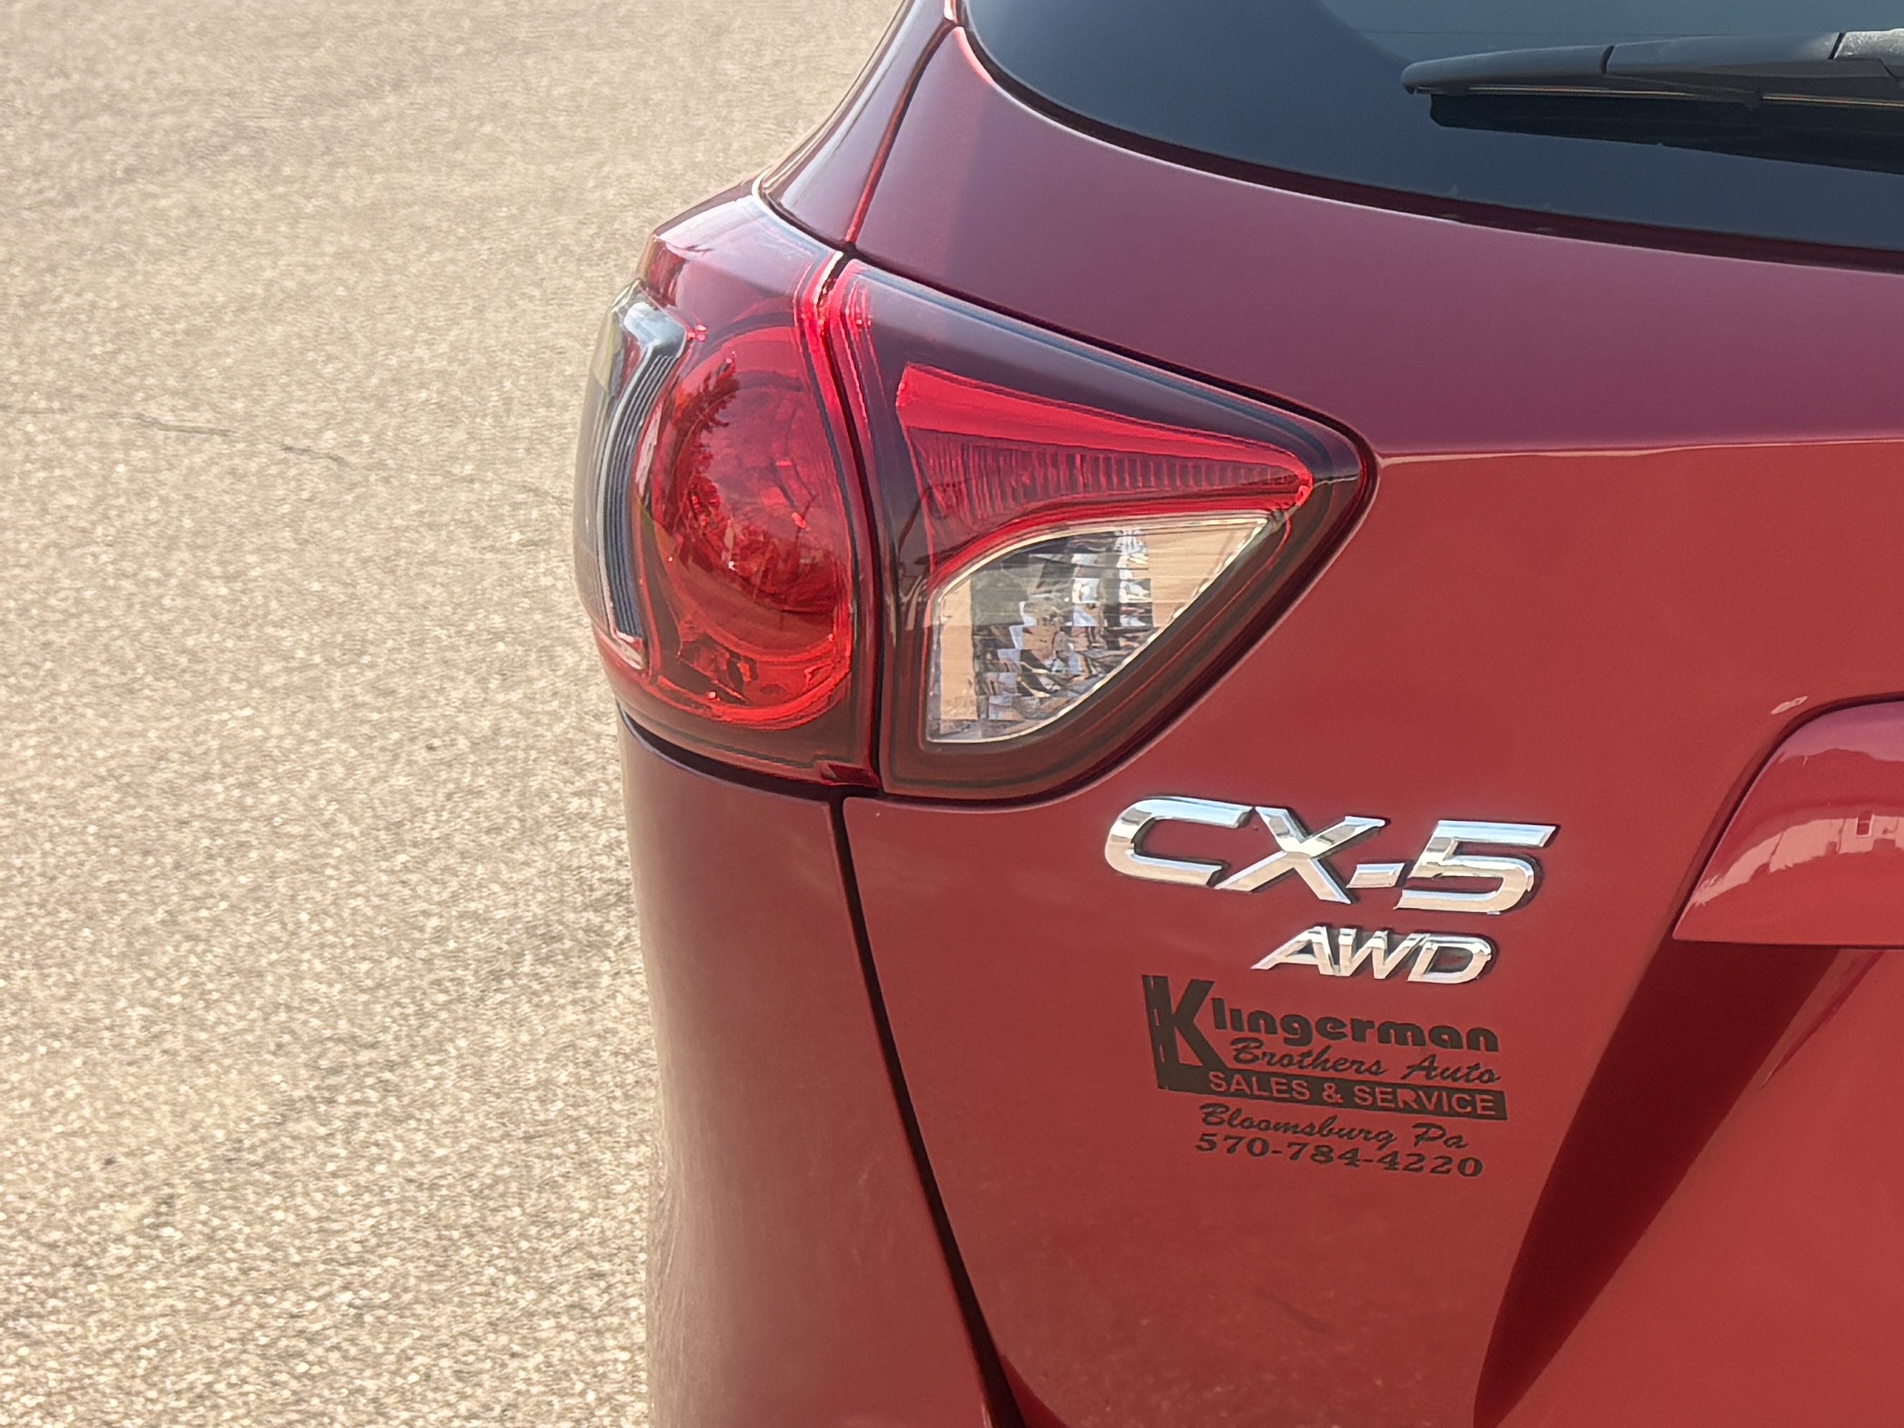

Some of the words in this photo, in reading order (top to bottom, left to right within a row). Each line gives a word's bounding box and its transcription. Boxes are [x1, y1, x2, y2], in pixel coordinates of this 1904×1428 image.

[1103, 795, 1561, 916] CX-5
[1250, 924, 1496, 985] AWD
[1141, 974, 1500, 1070] Klingerman
[1230, 1037, 1388, 1081] Brothers
[1401, 1053, 1501, 1086] Auto
[1208, 1071, 1312, 1102] SALES
[1321, 1082, 1345, 1106] &
[1353, 1084, 1500, 1116] SERVICE
[1197, 1102, 1397, 1149] Bloomsburg
[1411, 1122, 1470, 1151] Pa
[1195, 1132, 1485, 1179] 570-784-4220
